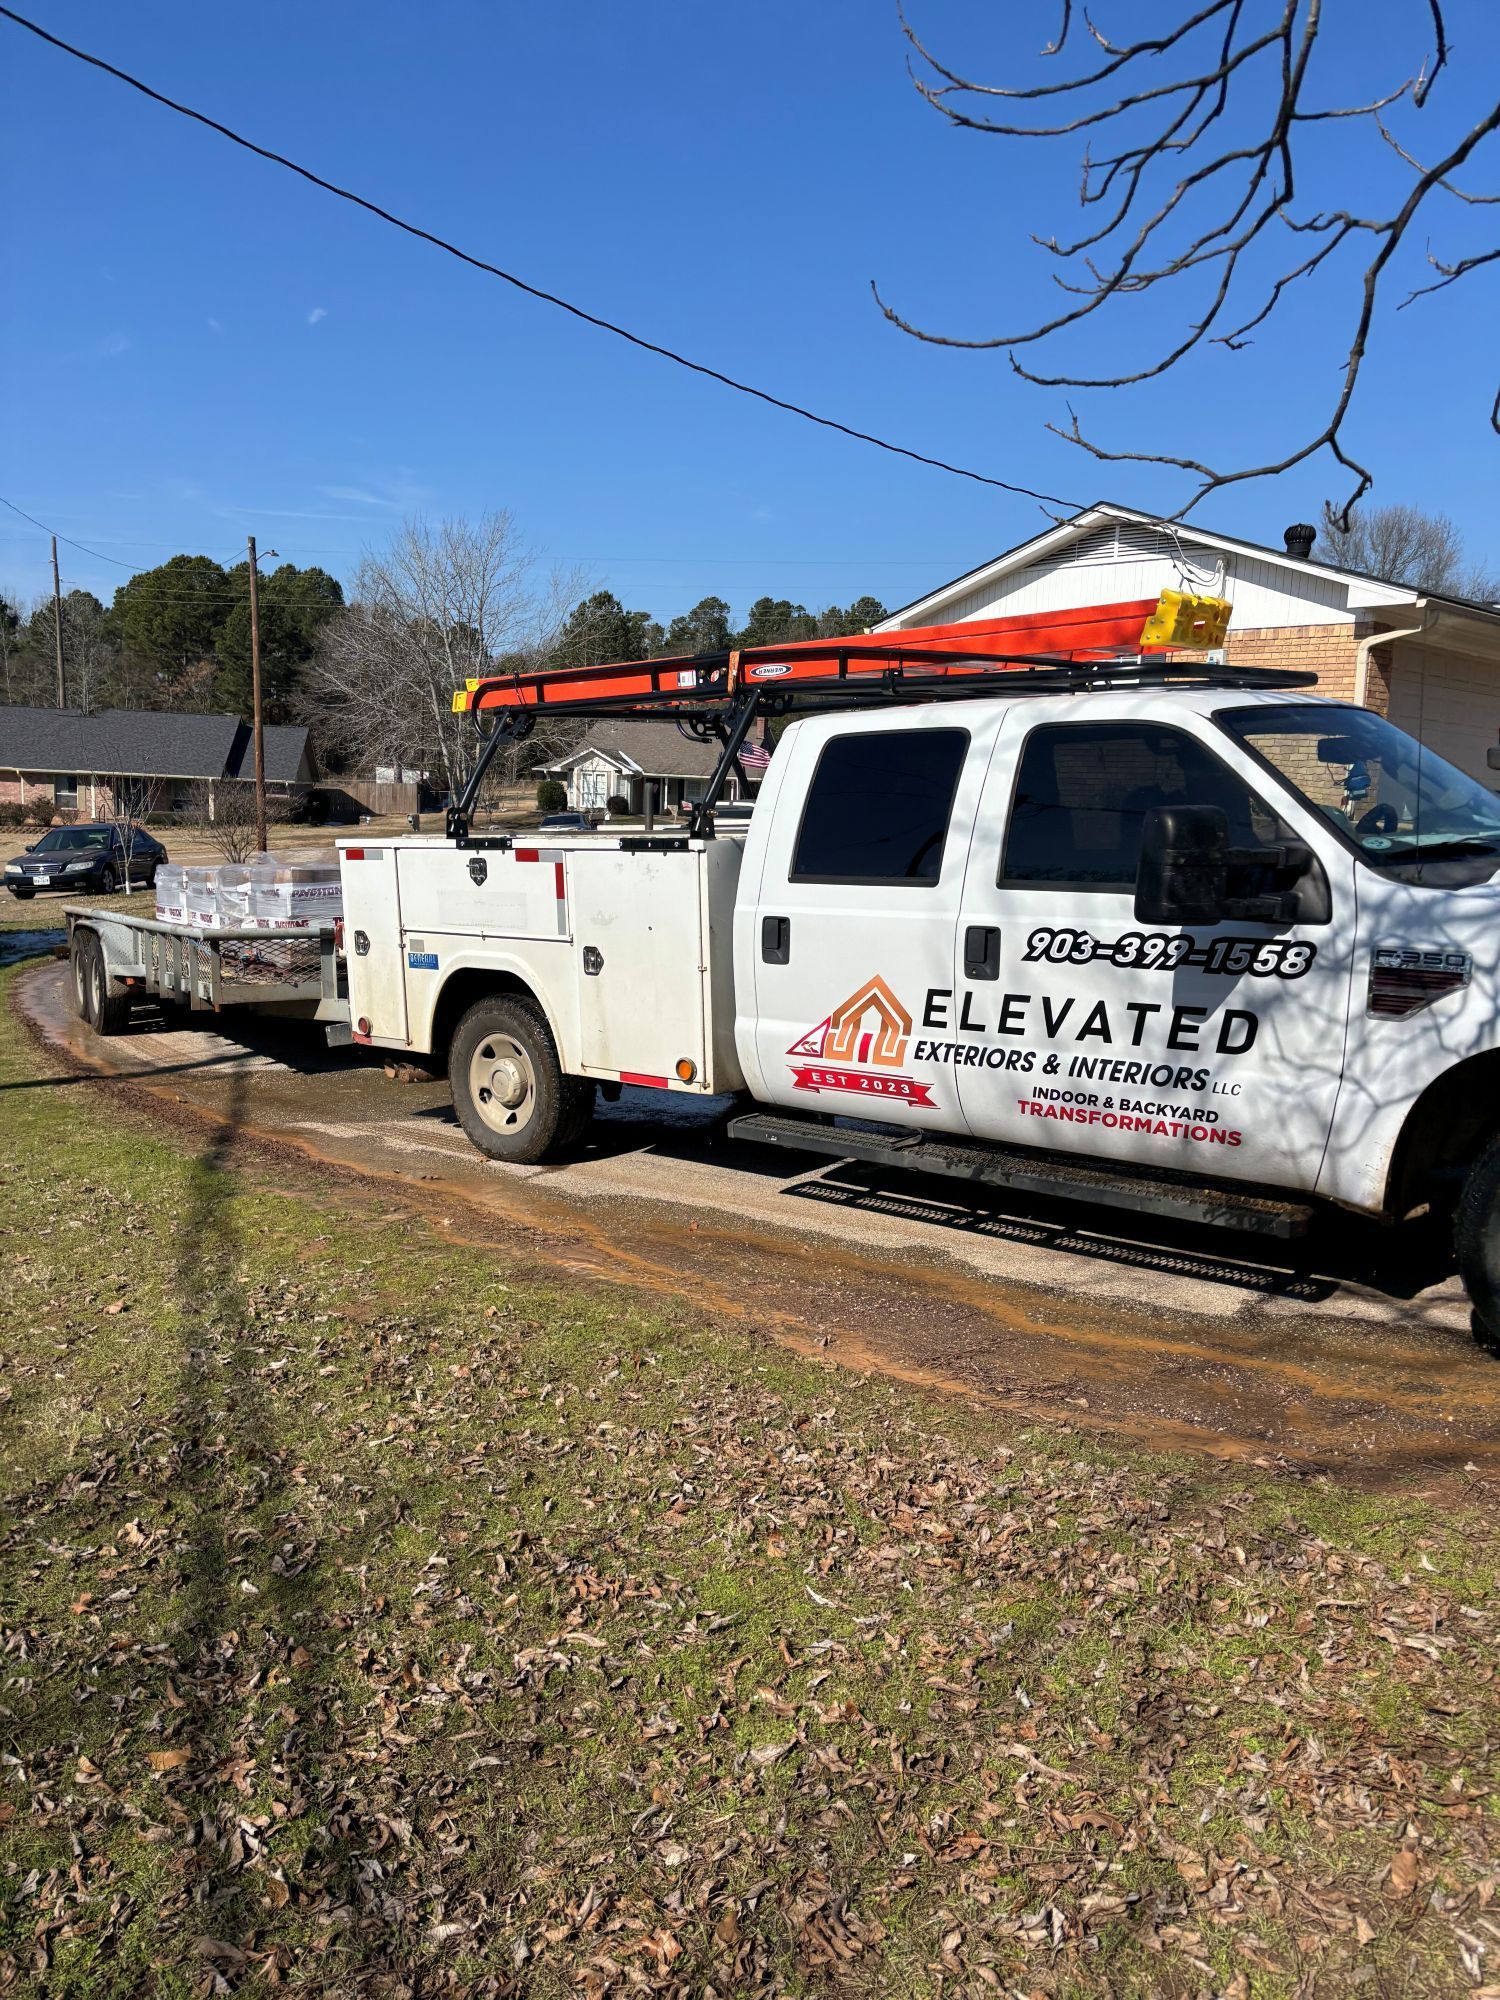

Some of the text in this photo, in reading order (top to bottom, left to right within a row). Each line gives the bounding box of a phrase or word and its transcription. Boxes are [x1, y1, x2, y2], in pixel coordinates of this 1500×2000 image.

[758, 667, 784, 675] WERNER
[1022, 928, 1316, 978] 903-399-1558
[922, 988, 1259, 1055] ELEVATED
[811, 1072, 911, 1095] EST 2023
[913, 1040, 1242, 1097] EXTERIORS & INTERIORS LLC
[1018, 1100, 1243, 1147] TRANSFORMATIONS
[1032, 1086, 1219, 1124] INDOOR & BACKYARD
